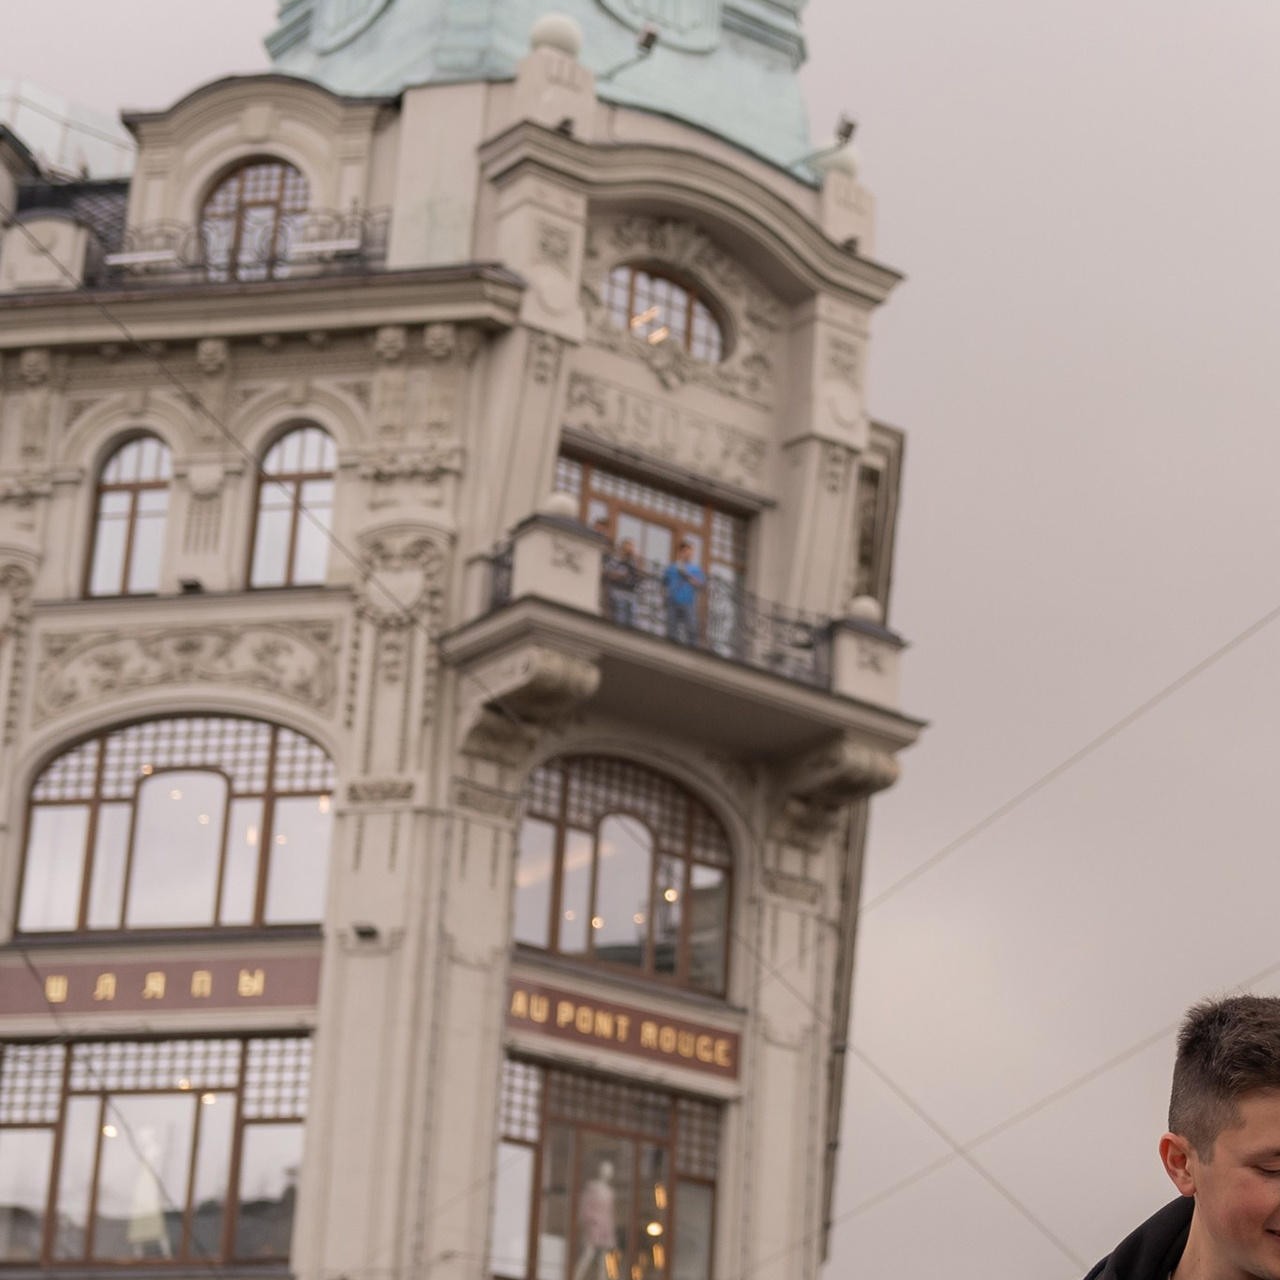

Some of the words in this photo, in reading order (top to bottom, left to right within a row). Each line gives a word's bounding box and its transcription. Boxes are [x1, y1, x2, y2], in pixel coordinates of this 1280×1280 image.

[45, 968, 265, 1003] ШЛЯПЫ
[511, 989, 549, 1024] AU
[556, 1000, 630, 1043] PONT
[640, 1021, 732, 1067] ROUGE
